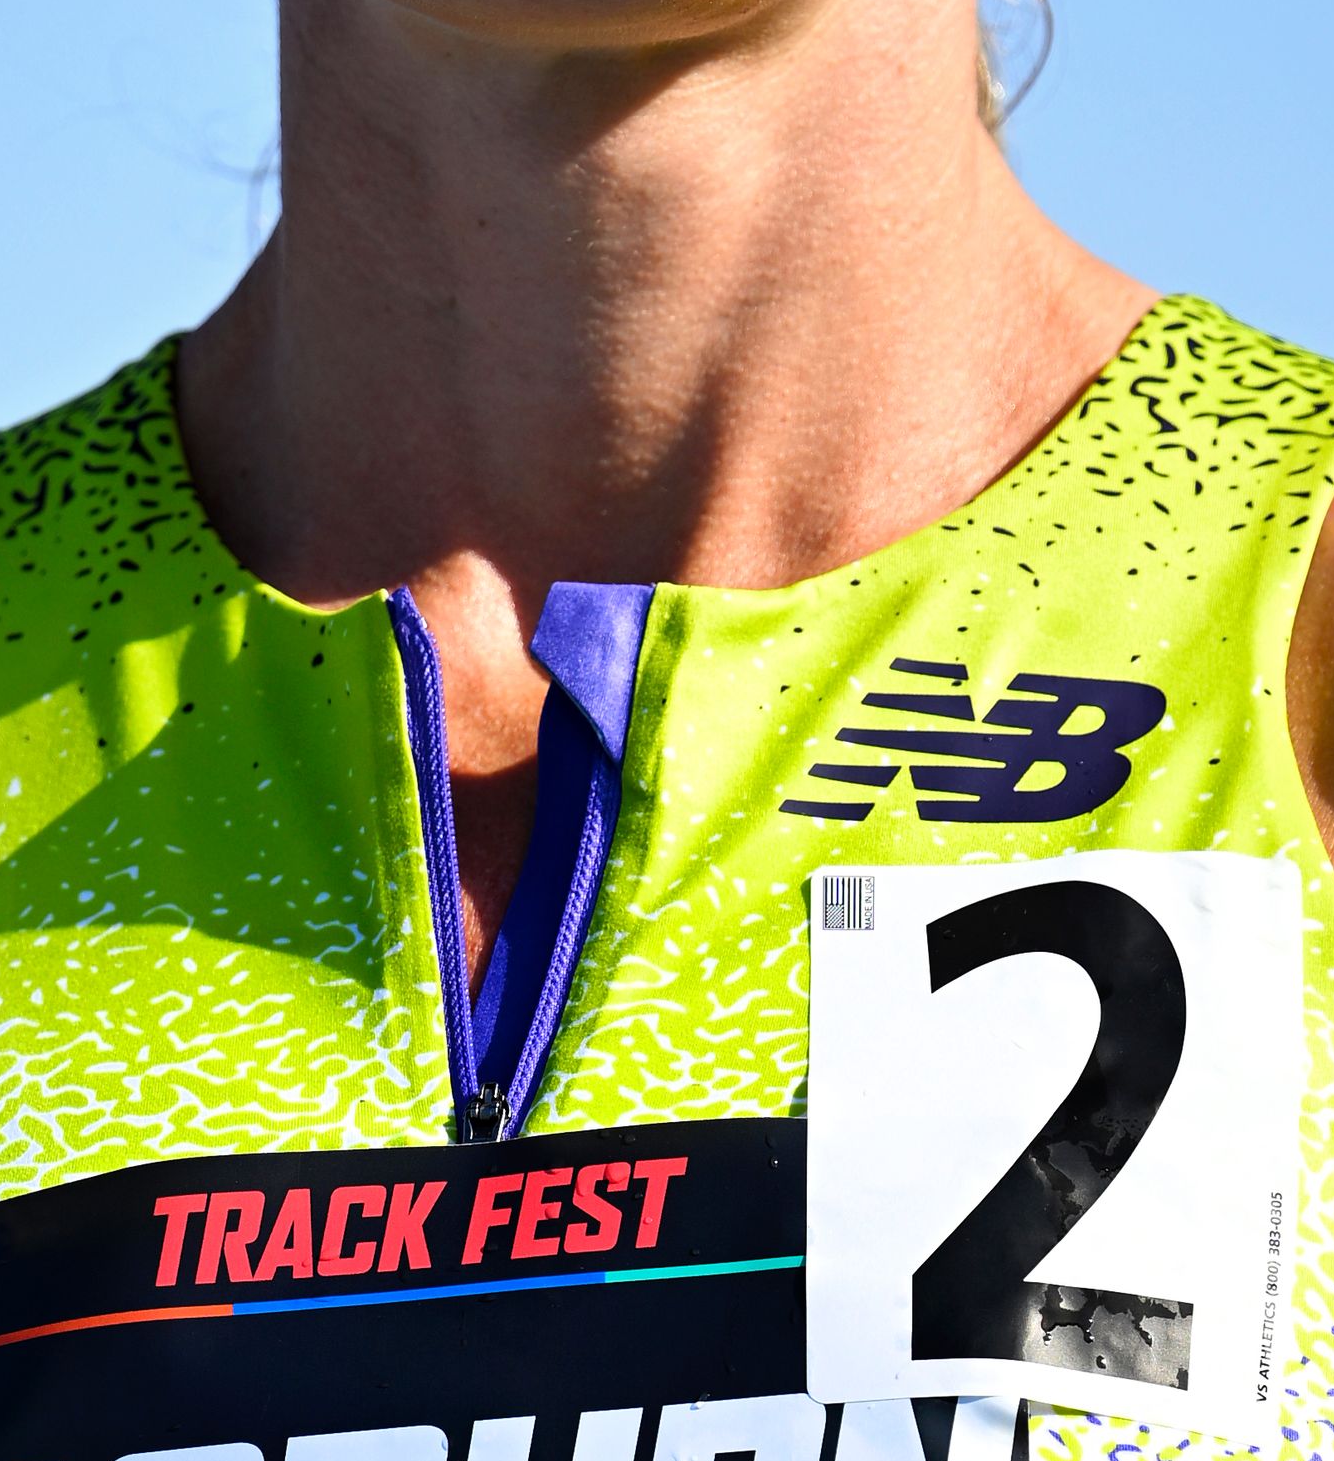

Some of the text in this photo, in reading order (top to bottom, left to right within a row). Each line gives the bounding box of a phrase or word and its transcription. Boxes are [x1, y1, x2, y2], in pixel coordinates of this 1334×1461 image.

[864, 878, 873, 893] USA
[864, 907, 873, 929] MADE
[912, 880, 1194, 1391] 2
[153, 1157, 689, 1287] TRACK FEST
[1256, 1192, 1283, 1402] VS ATHLETICS (800) 383-0305
